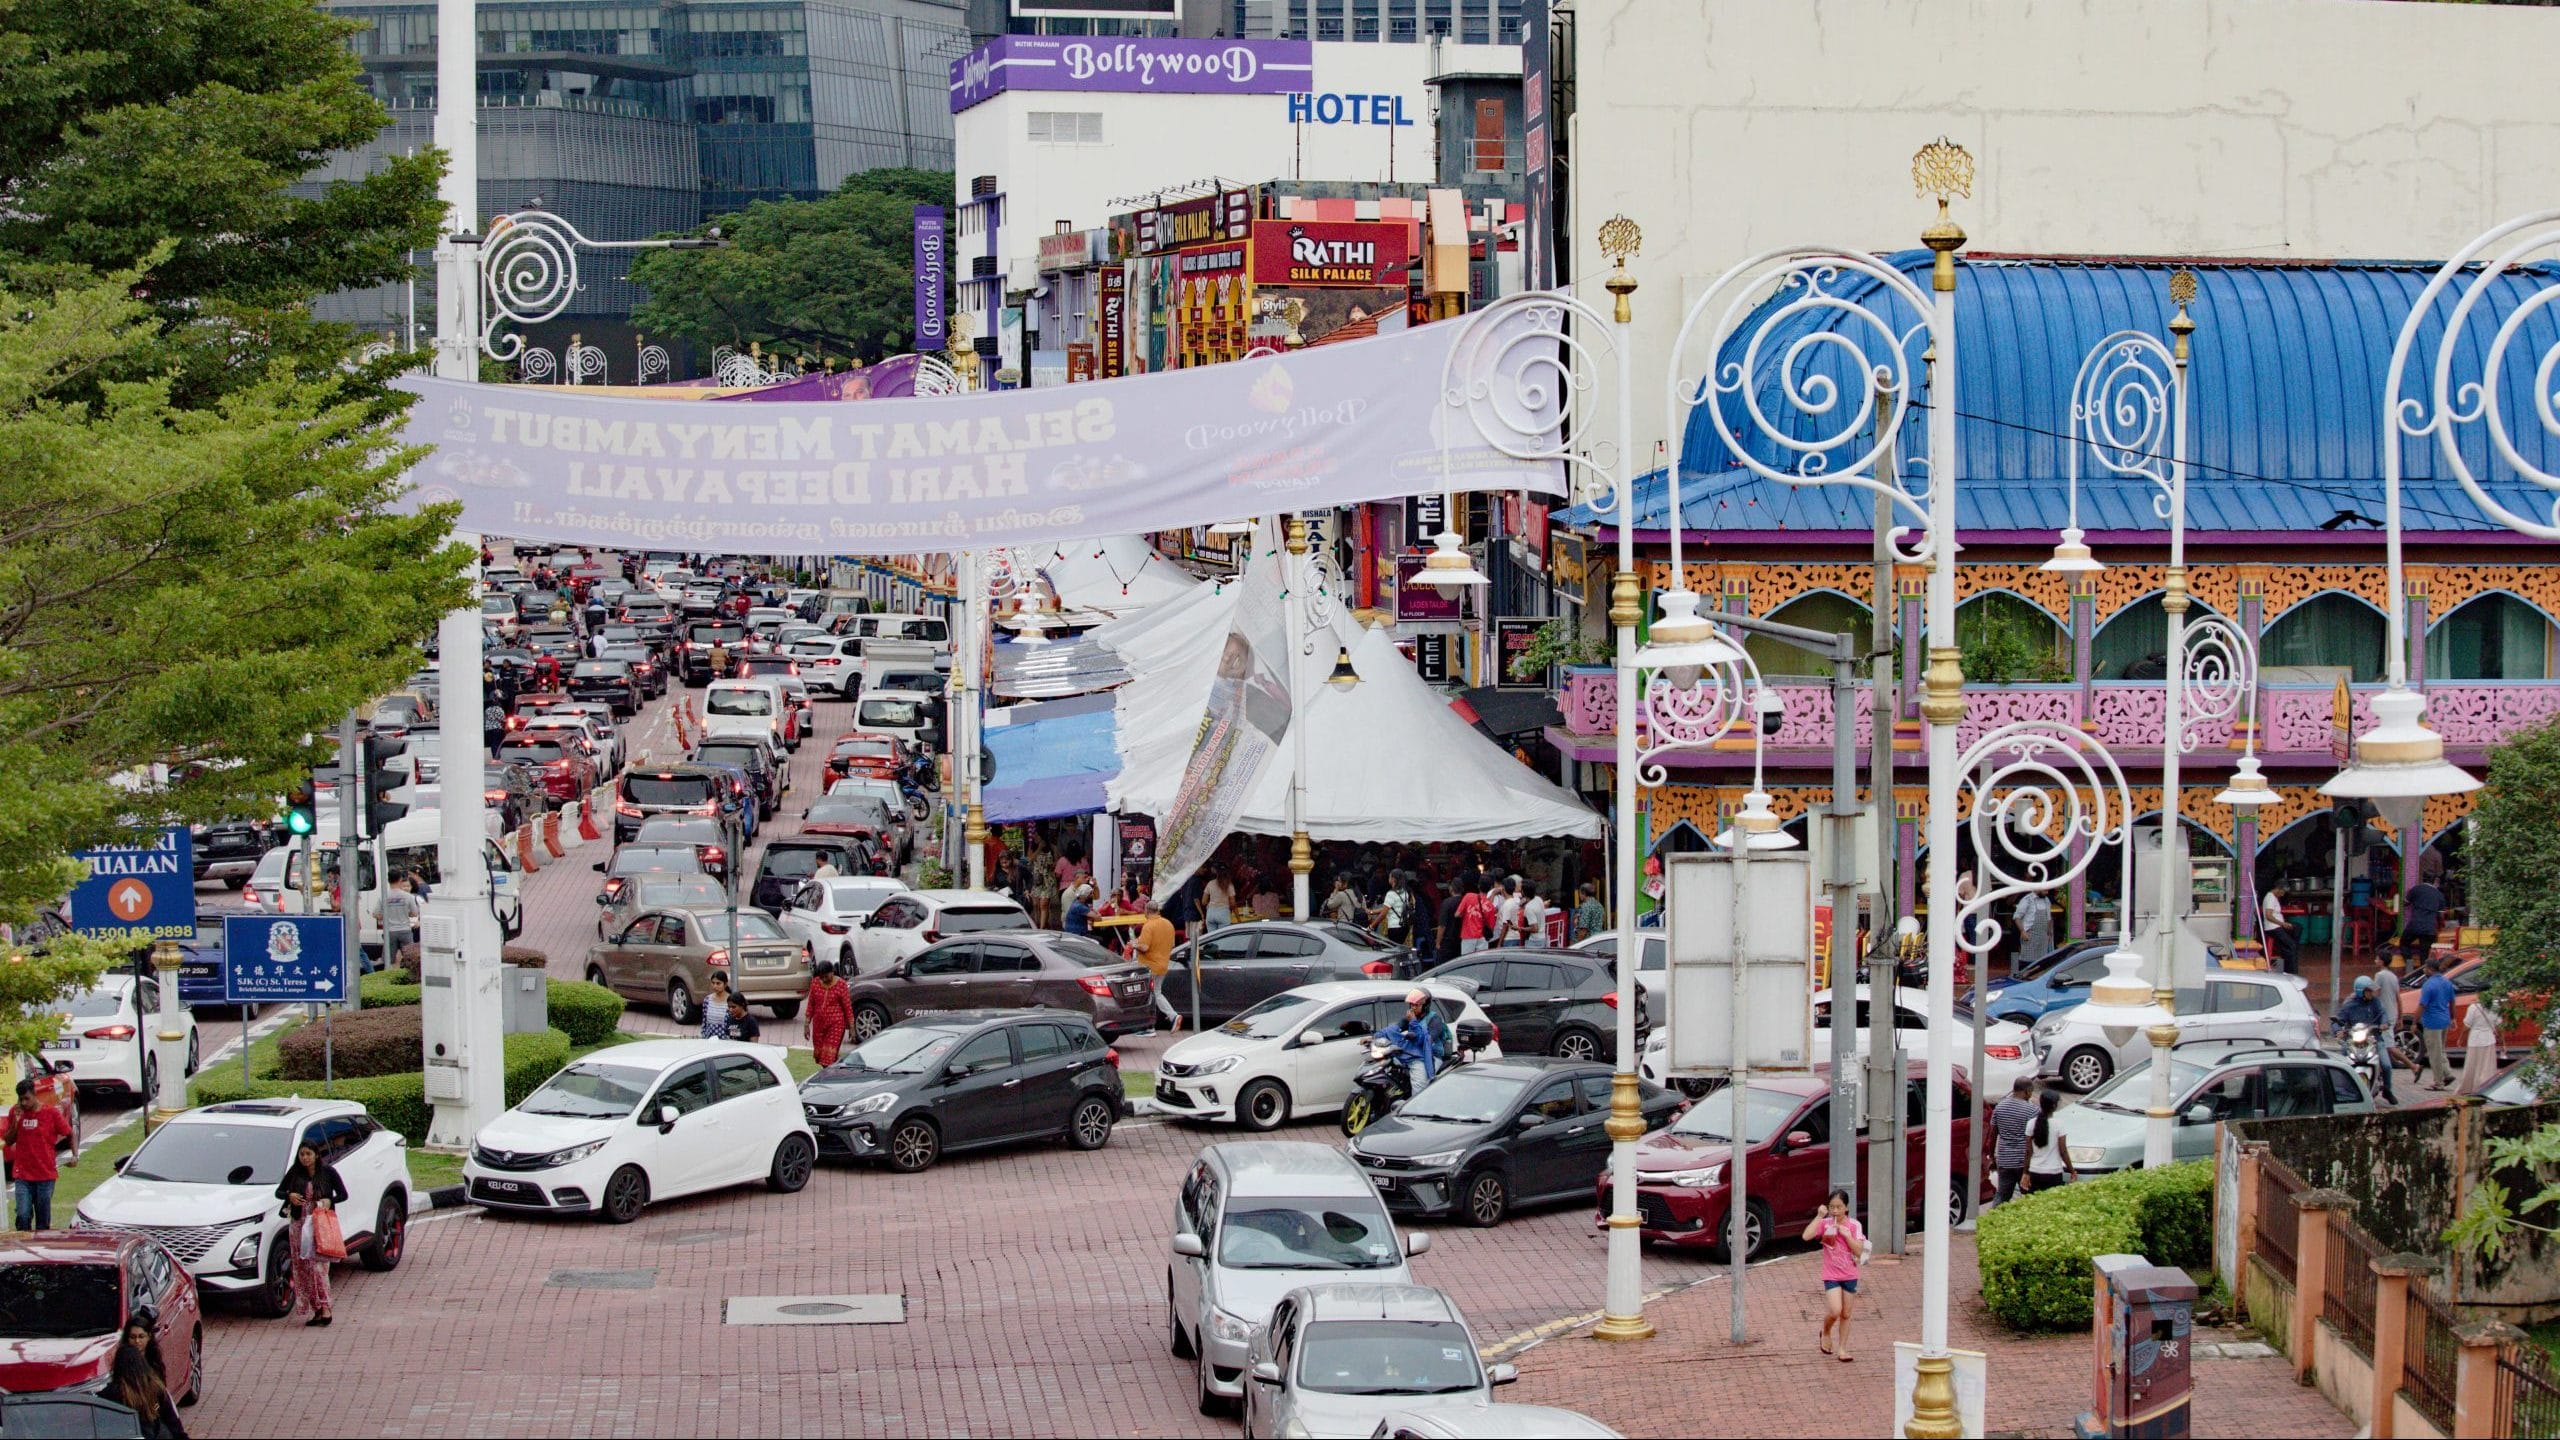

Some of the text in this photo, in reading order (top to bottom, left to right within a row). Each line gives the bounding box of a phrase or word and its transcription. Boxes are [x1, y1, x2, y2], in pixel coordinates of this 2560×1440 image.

[1288, 93, 1413, 126] HOTEL
[1155, 209, 1211, 250] RATHI SILK PALACE
[1292, 237, 1375, 267] RATHI
[1290, 268, 1372, 281] SILK PALACE
[1106, 297, 1121, 338] RATHI
[1107, 341, 1118, 367] SILK
[1107, 369, 1118, 378] P
[1302, 509, 1332, 518] RISHALA
[154, 925, 194, 938] 9898
[237, 978, 254, 986] SJK
[255, 978, 269, 987] (C)
[283, 978, 307, 986] Teresa
